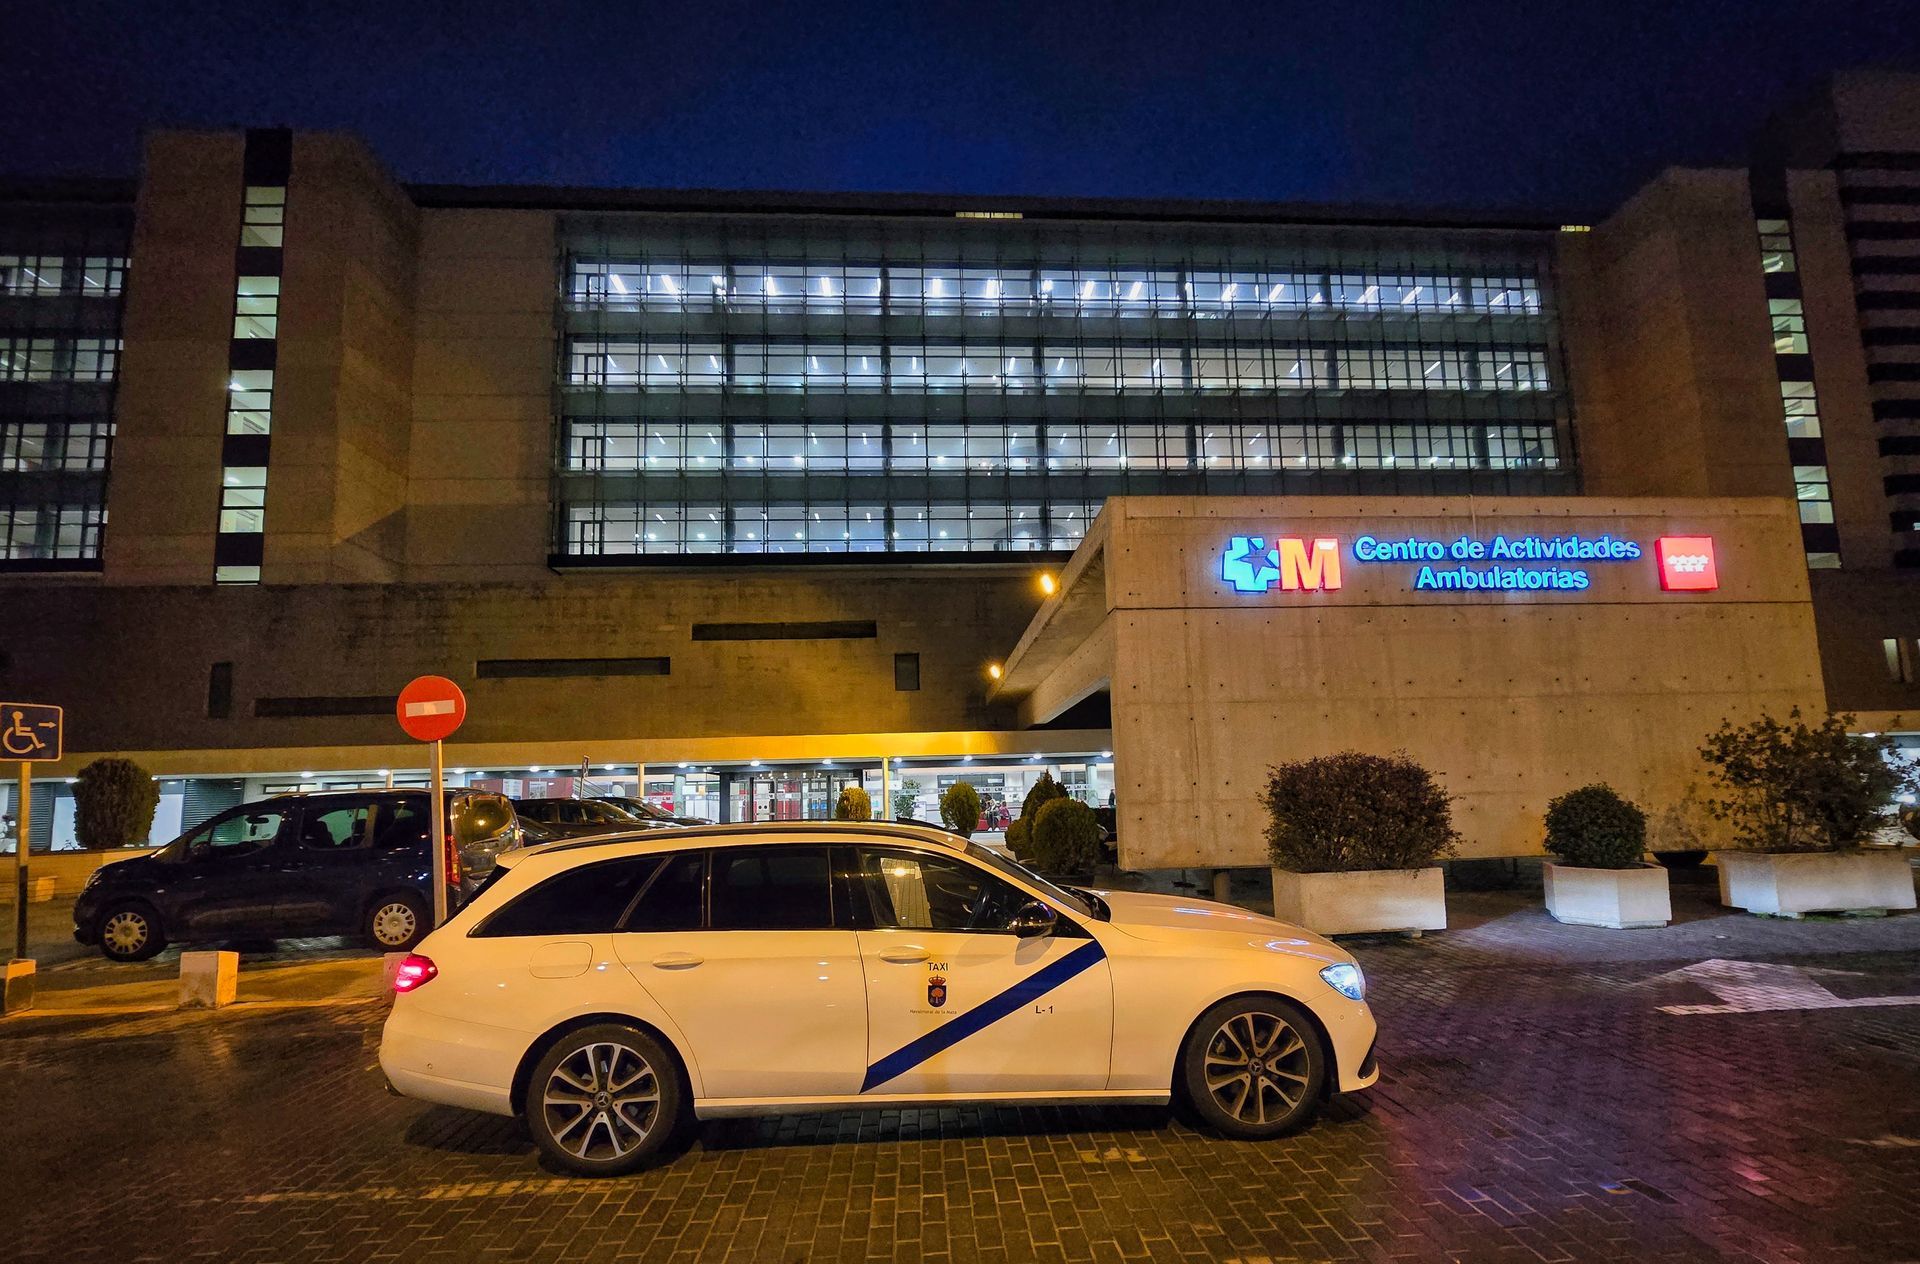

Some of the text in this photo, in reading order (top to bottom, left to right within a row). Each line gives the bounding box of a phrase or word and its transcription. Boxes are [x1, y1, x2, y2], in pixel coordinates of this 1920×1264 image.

[1354, 536, 1641, 560] Centro de Actividades
[1416, 565, 1589, 589] Ambulatorias
[927, 962, 949, 971] TAXI
